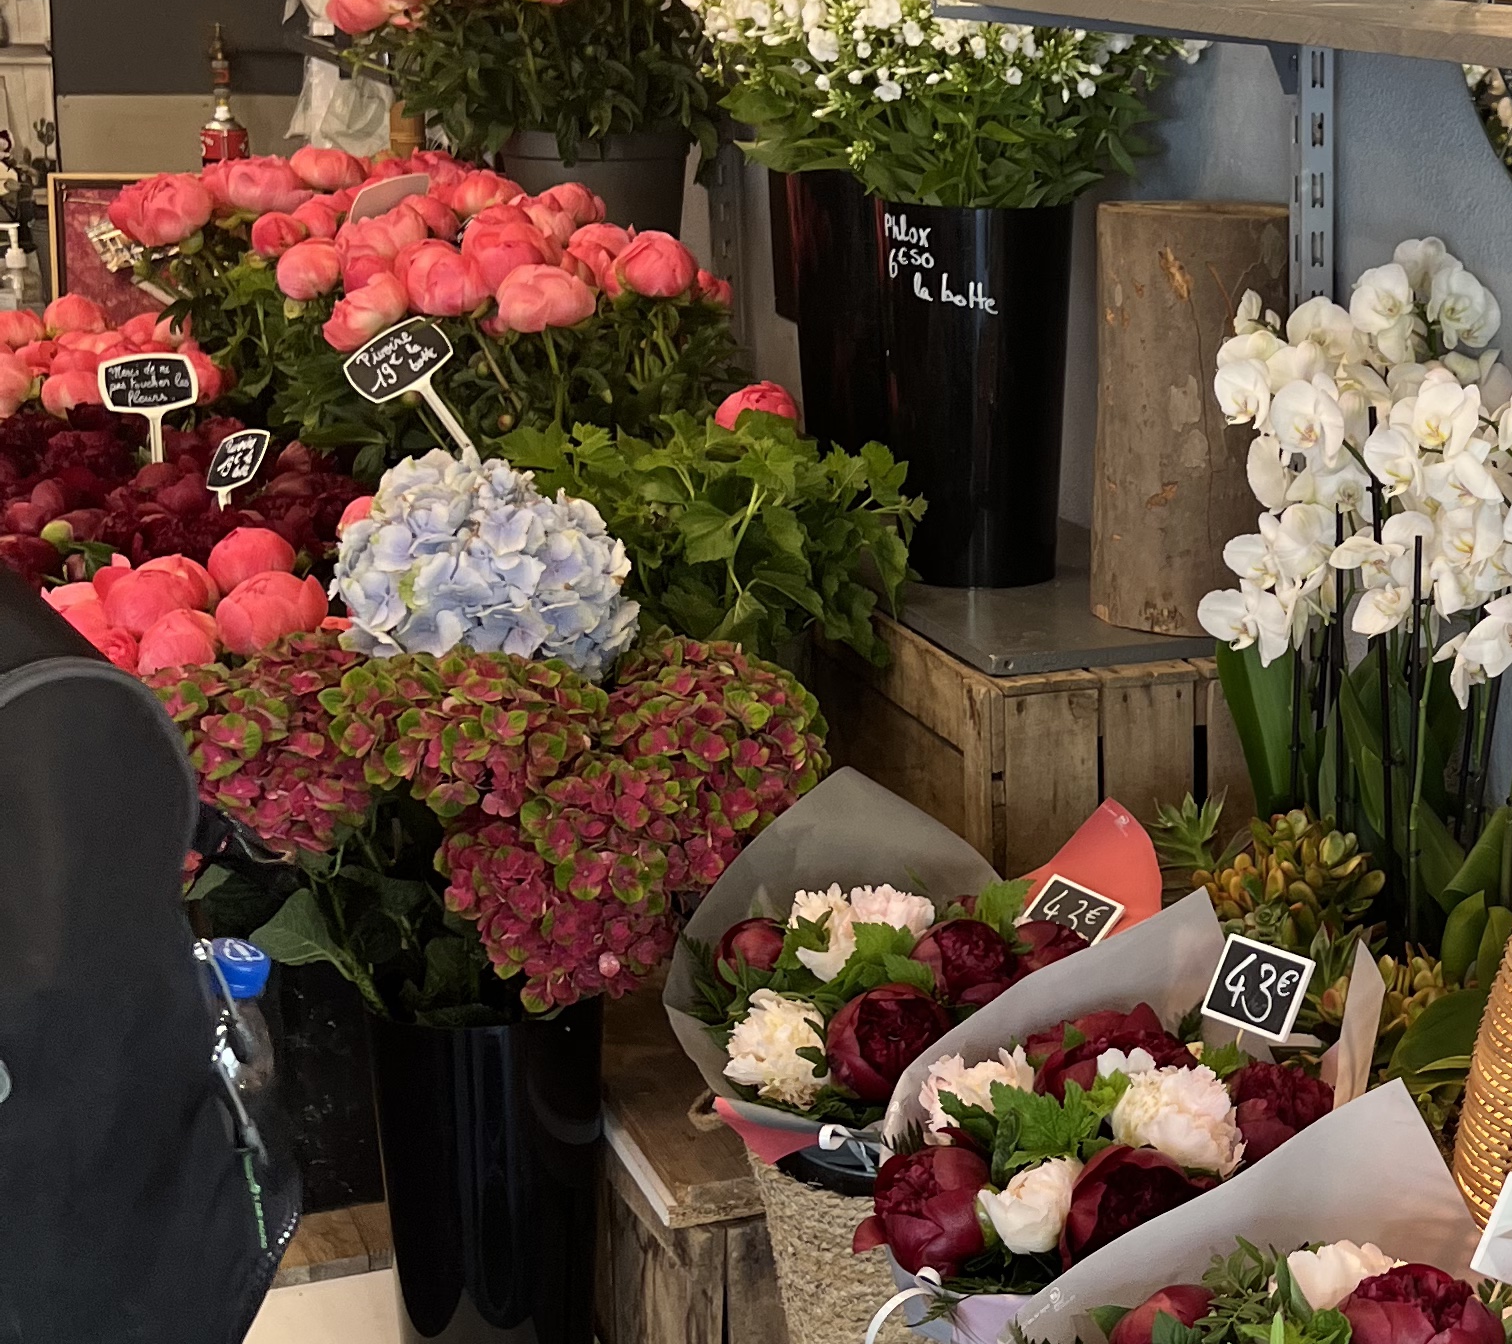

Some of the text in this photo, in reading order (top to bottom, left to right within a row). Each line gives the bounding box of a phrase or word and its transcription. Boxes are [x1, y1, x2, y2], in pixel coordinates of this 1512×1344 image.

[884, 212, 932, 248] Phlox
[913, 271, 999, 315] la botte
[355, 331, 413, 368] Pivoine
[1224, 952, 1300, 1023] 43€
